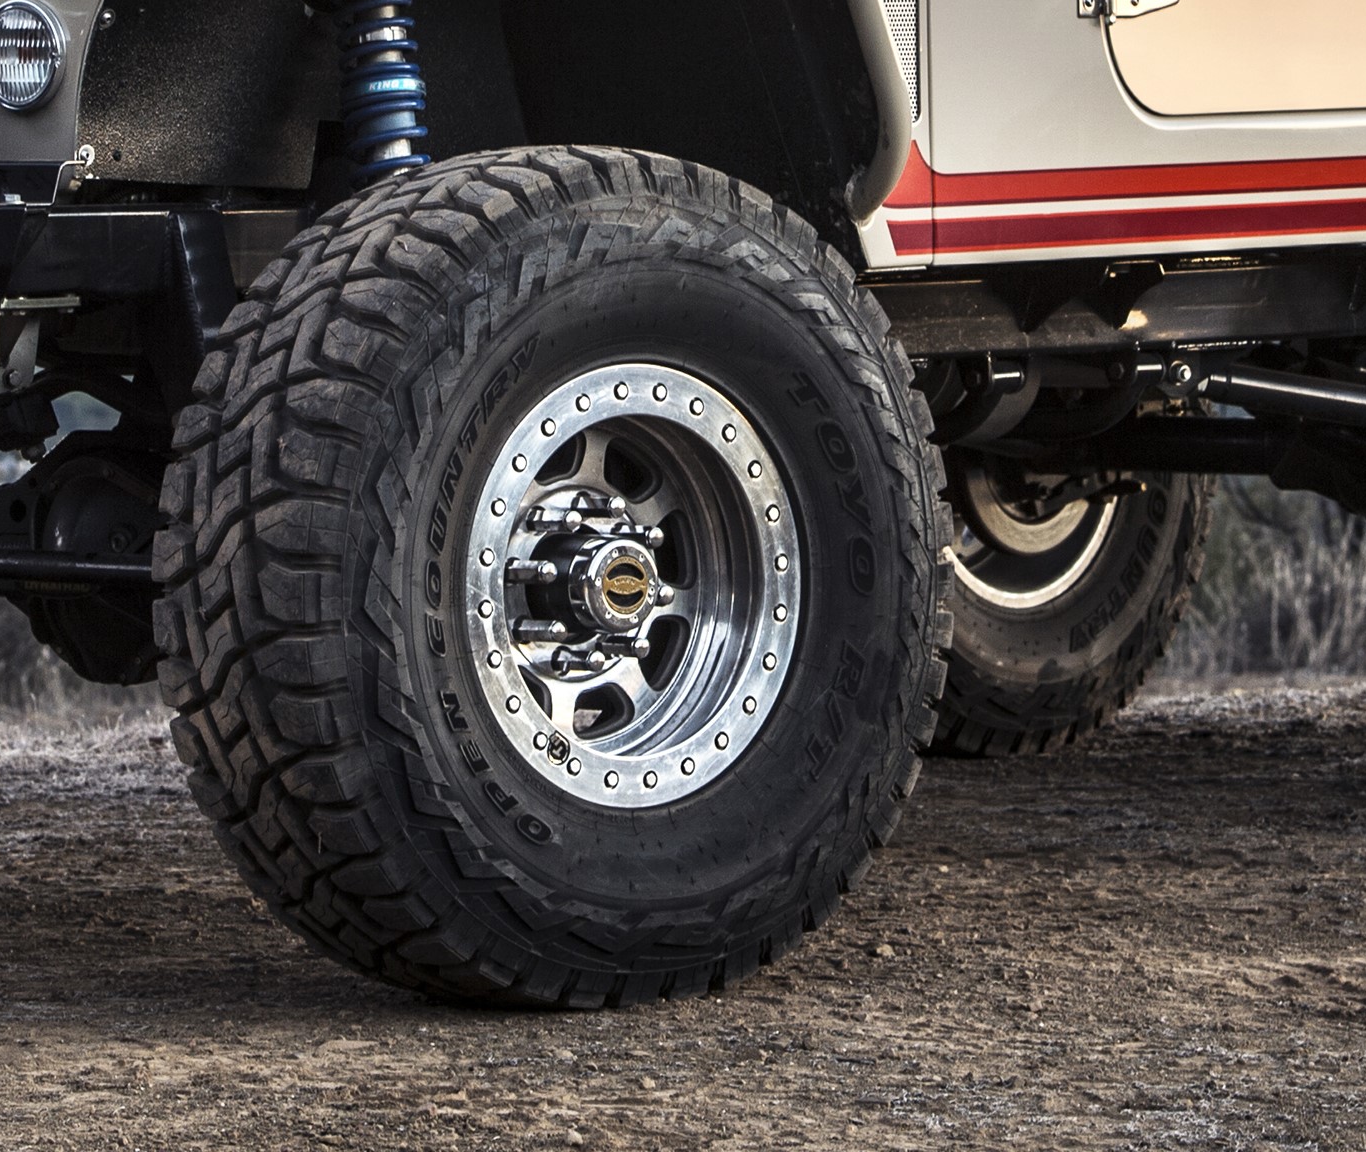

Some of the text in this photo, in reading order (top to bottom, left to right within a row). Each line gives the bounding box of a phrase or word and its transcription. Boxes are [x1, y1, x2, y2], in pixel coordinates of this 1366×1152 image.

[368, 79, 400, 91] KING
[424, 325, 544, 659] COUNTRY
[787, 370, 877, 783] TOYO R/T
[439, 688, 555, 847] OPEN
